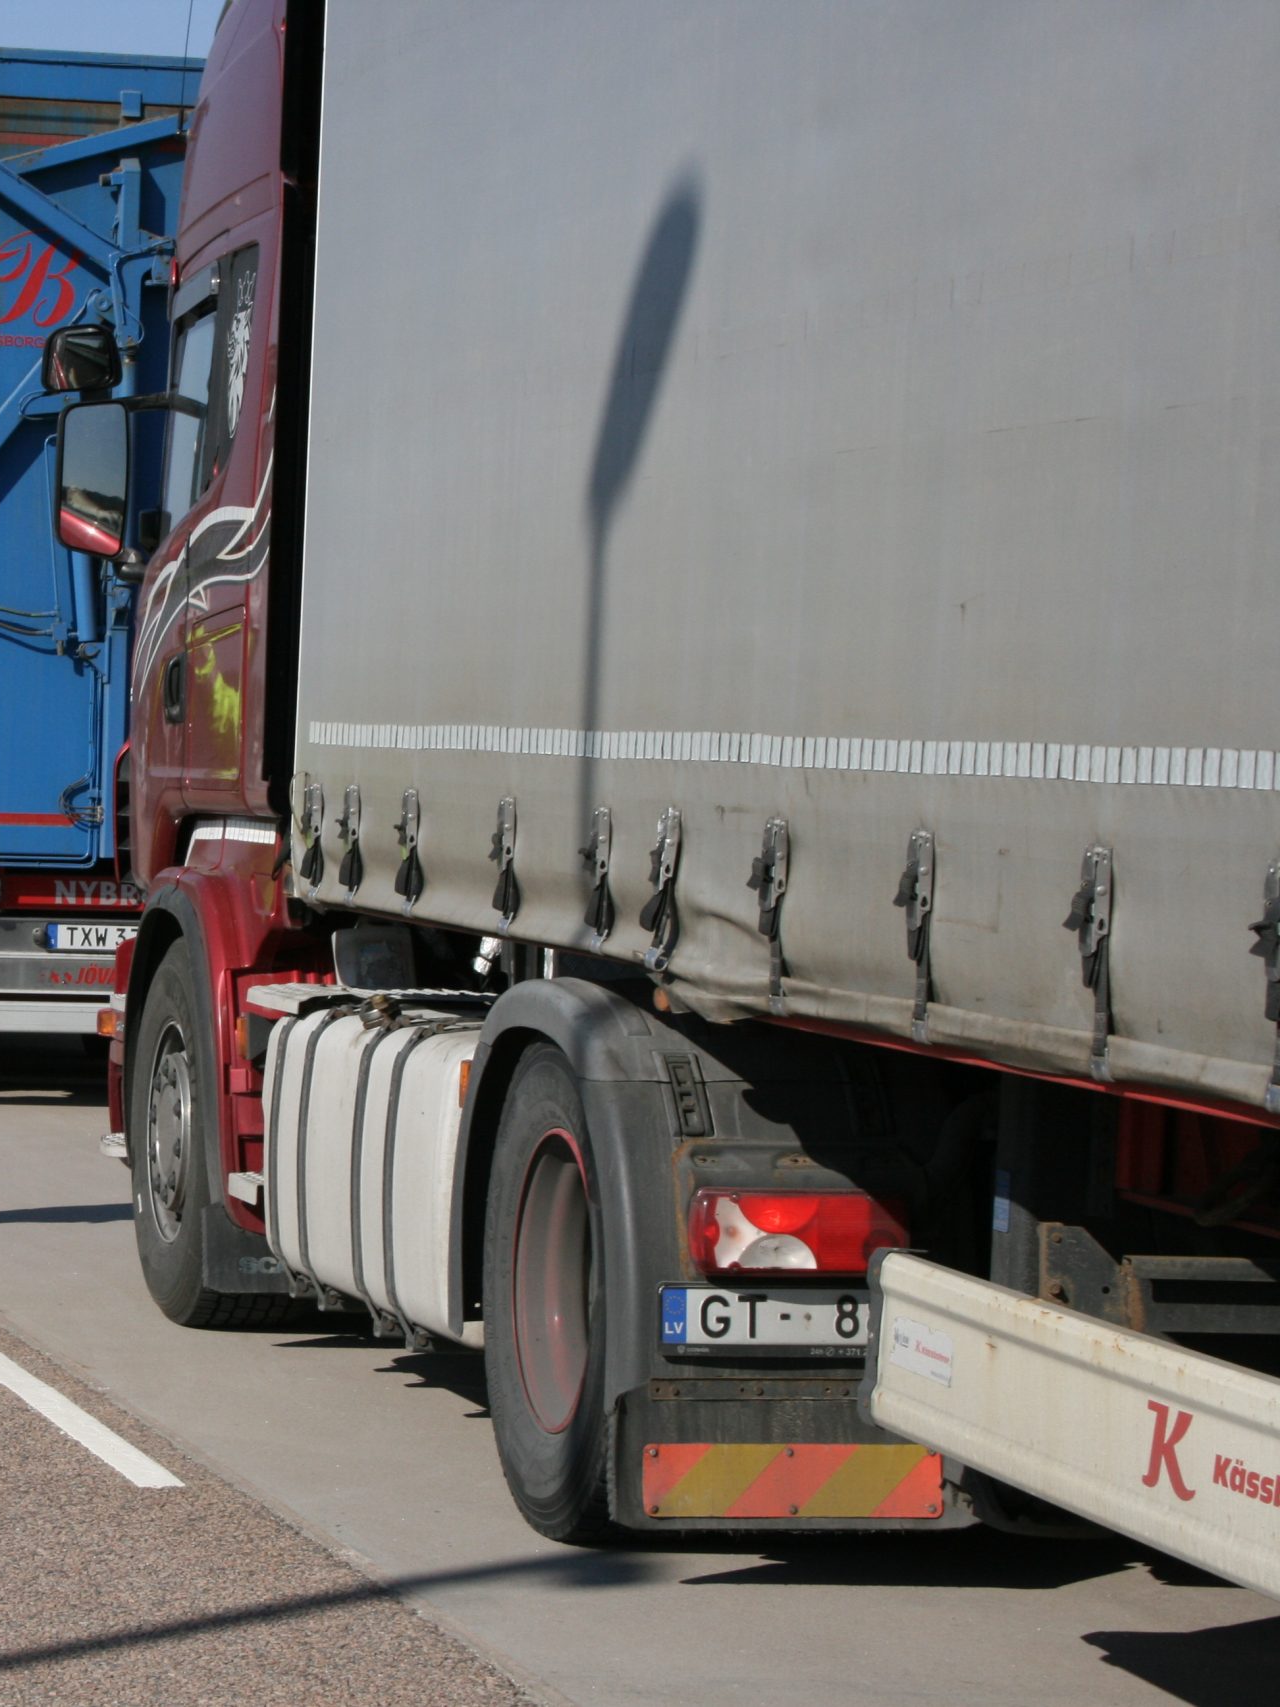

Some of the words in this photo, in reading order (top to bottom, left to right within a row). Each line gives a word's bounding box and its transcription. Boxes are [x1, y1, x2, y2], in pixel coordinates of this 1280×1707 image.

[54, 880, 145, 905] NYBR
[67, 927, 108, 946] TXW
[115, 928, 138, 945] 3
[664, 1321, 684, 1334] LV
[835, 1294, 869, 1339] 8
[1142, 1400, 1196, 1502] K
